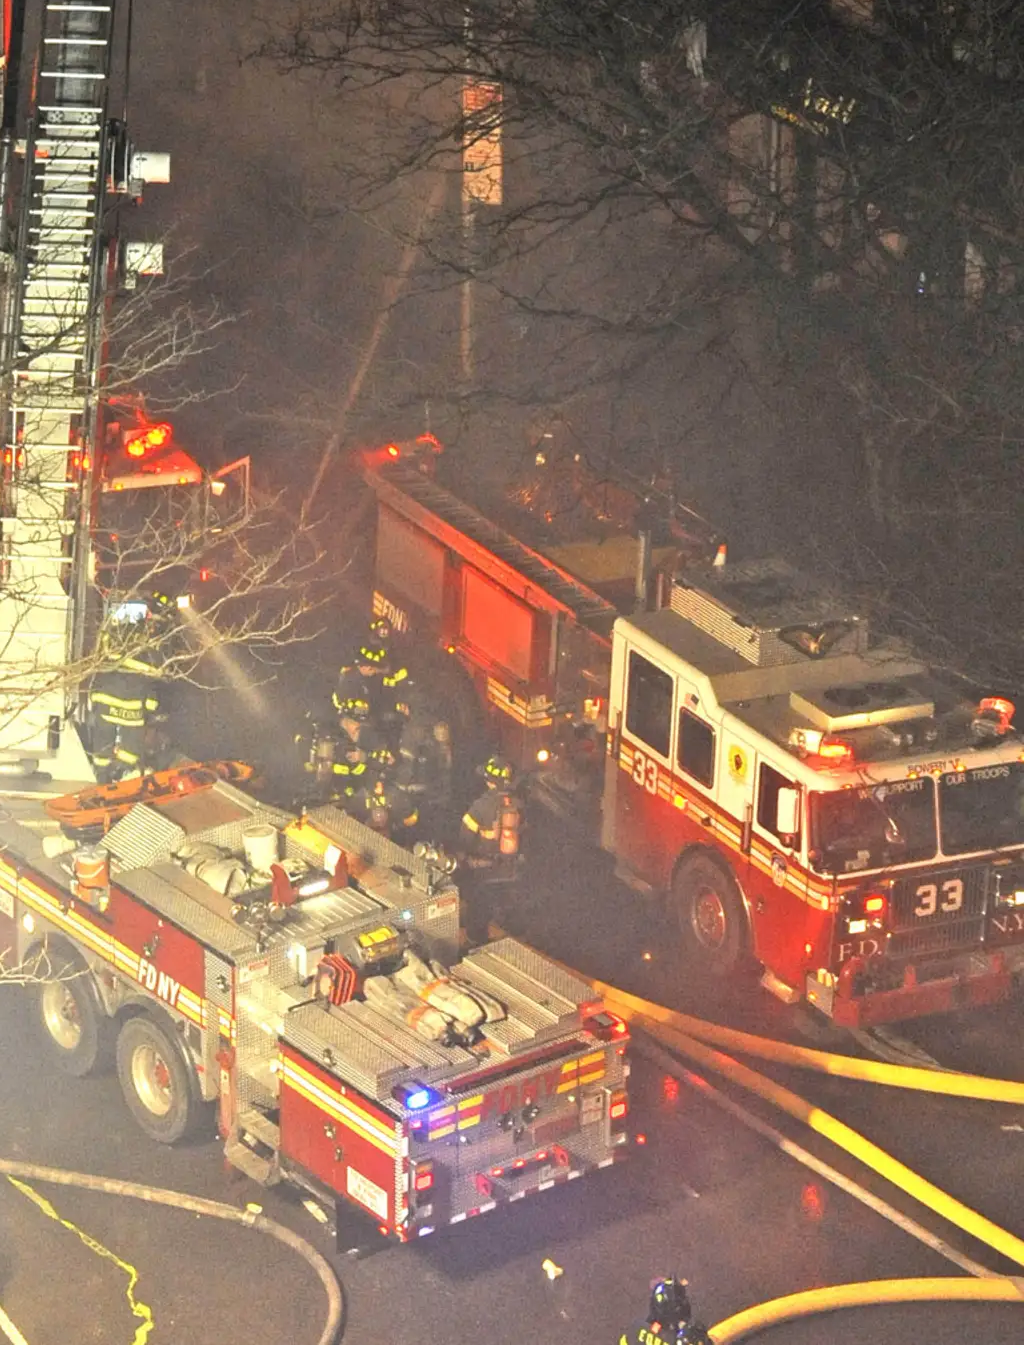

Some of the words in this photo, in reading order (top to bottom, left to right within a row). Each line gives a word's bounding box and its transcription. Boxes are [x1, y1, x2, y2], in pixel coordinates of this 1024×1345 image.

[632, 749, 658, 795] 33
[879, 780, 925, 795] UPPORT
[946, 773, 967, 786] OUR
[972, 766, 1010, 781] TROOPS
[915, 878, 963, 917] 33
